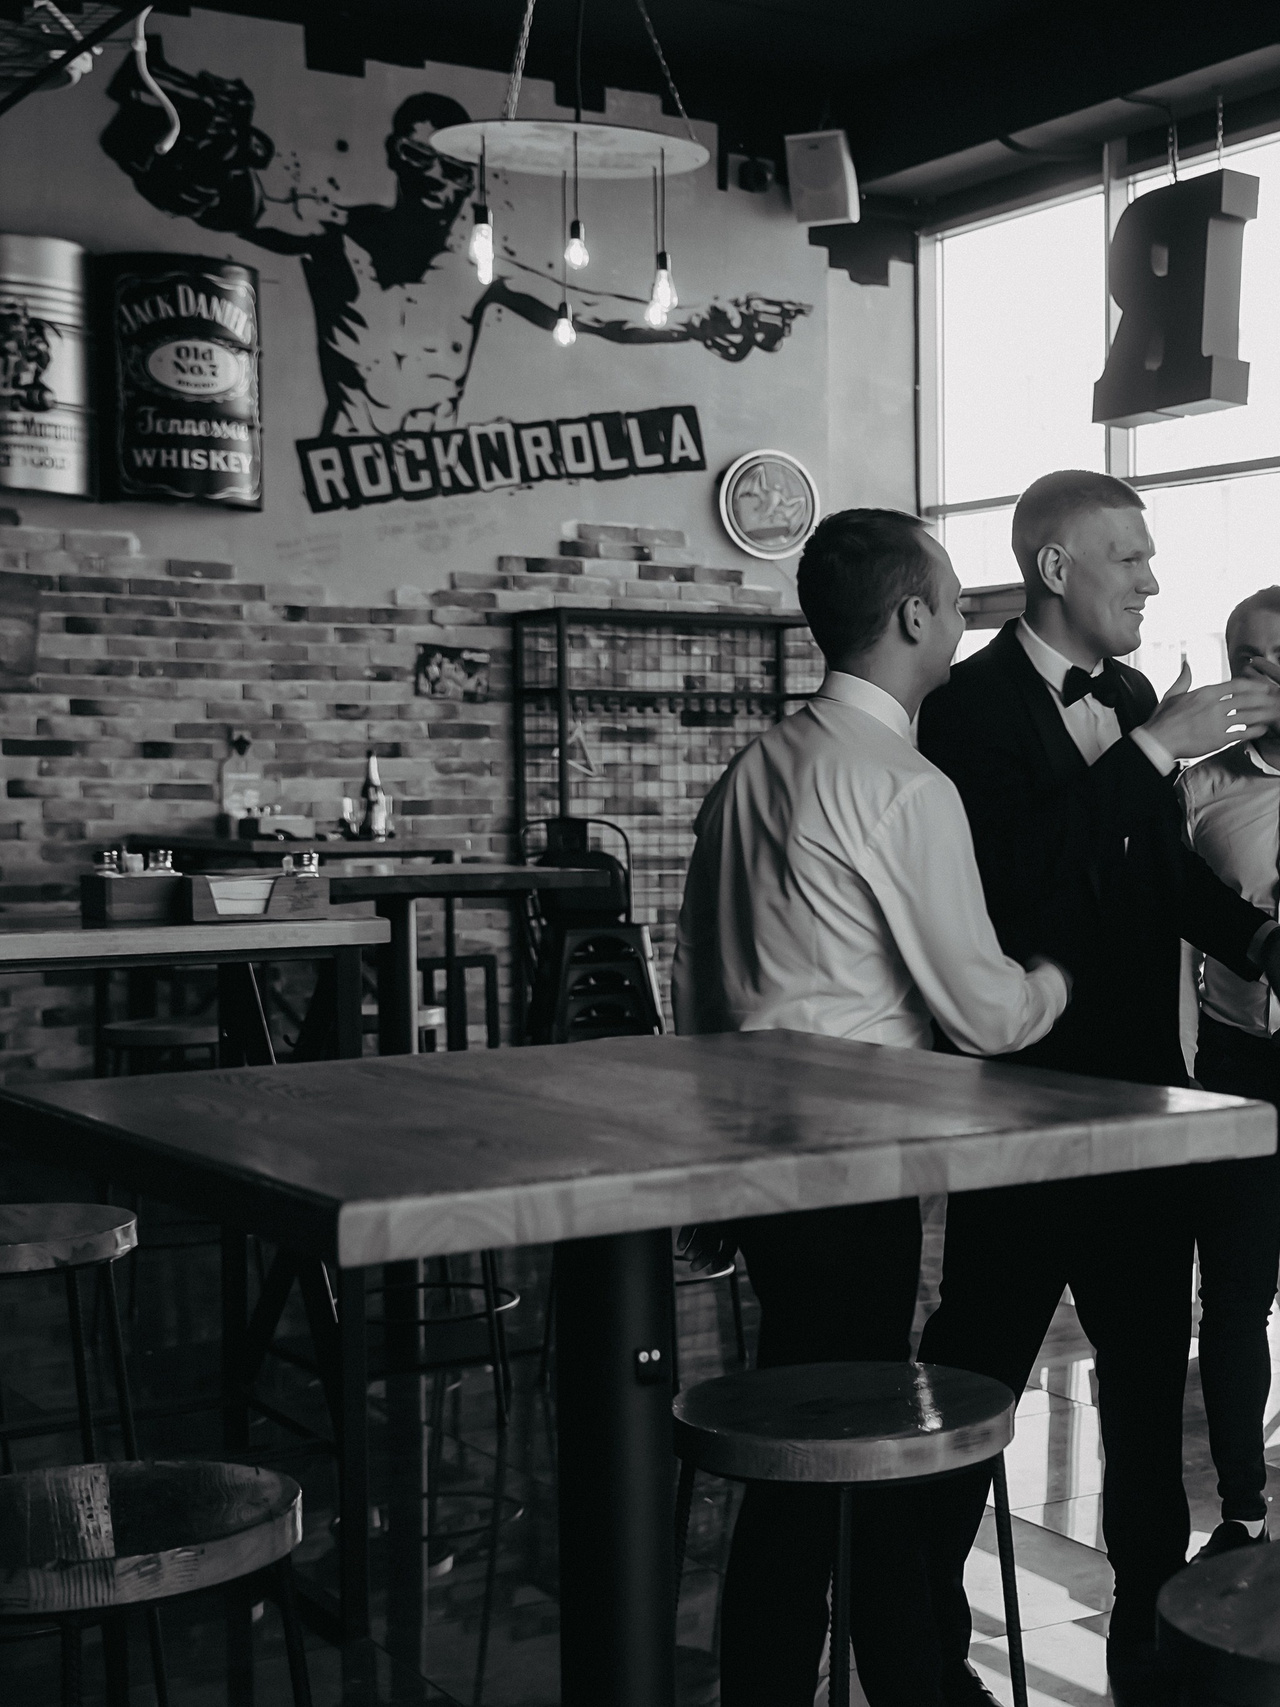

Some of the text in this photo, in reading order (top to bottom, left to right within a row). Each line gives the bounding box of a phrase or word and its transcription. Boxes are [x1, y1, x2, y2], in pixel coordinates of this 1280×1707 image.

[121, 294, 175, 335] JACK
[175, 345, 213, 361] Old
[138, 405, 249, 441] Tennessee
[132, 447, 253, 474] WHISKEY
[306, 412, 702, 505] ROCKNROLLA
